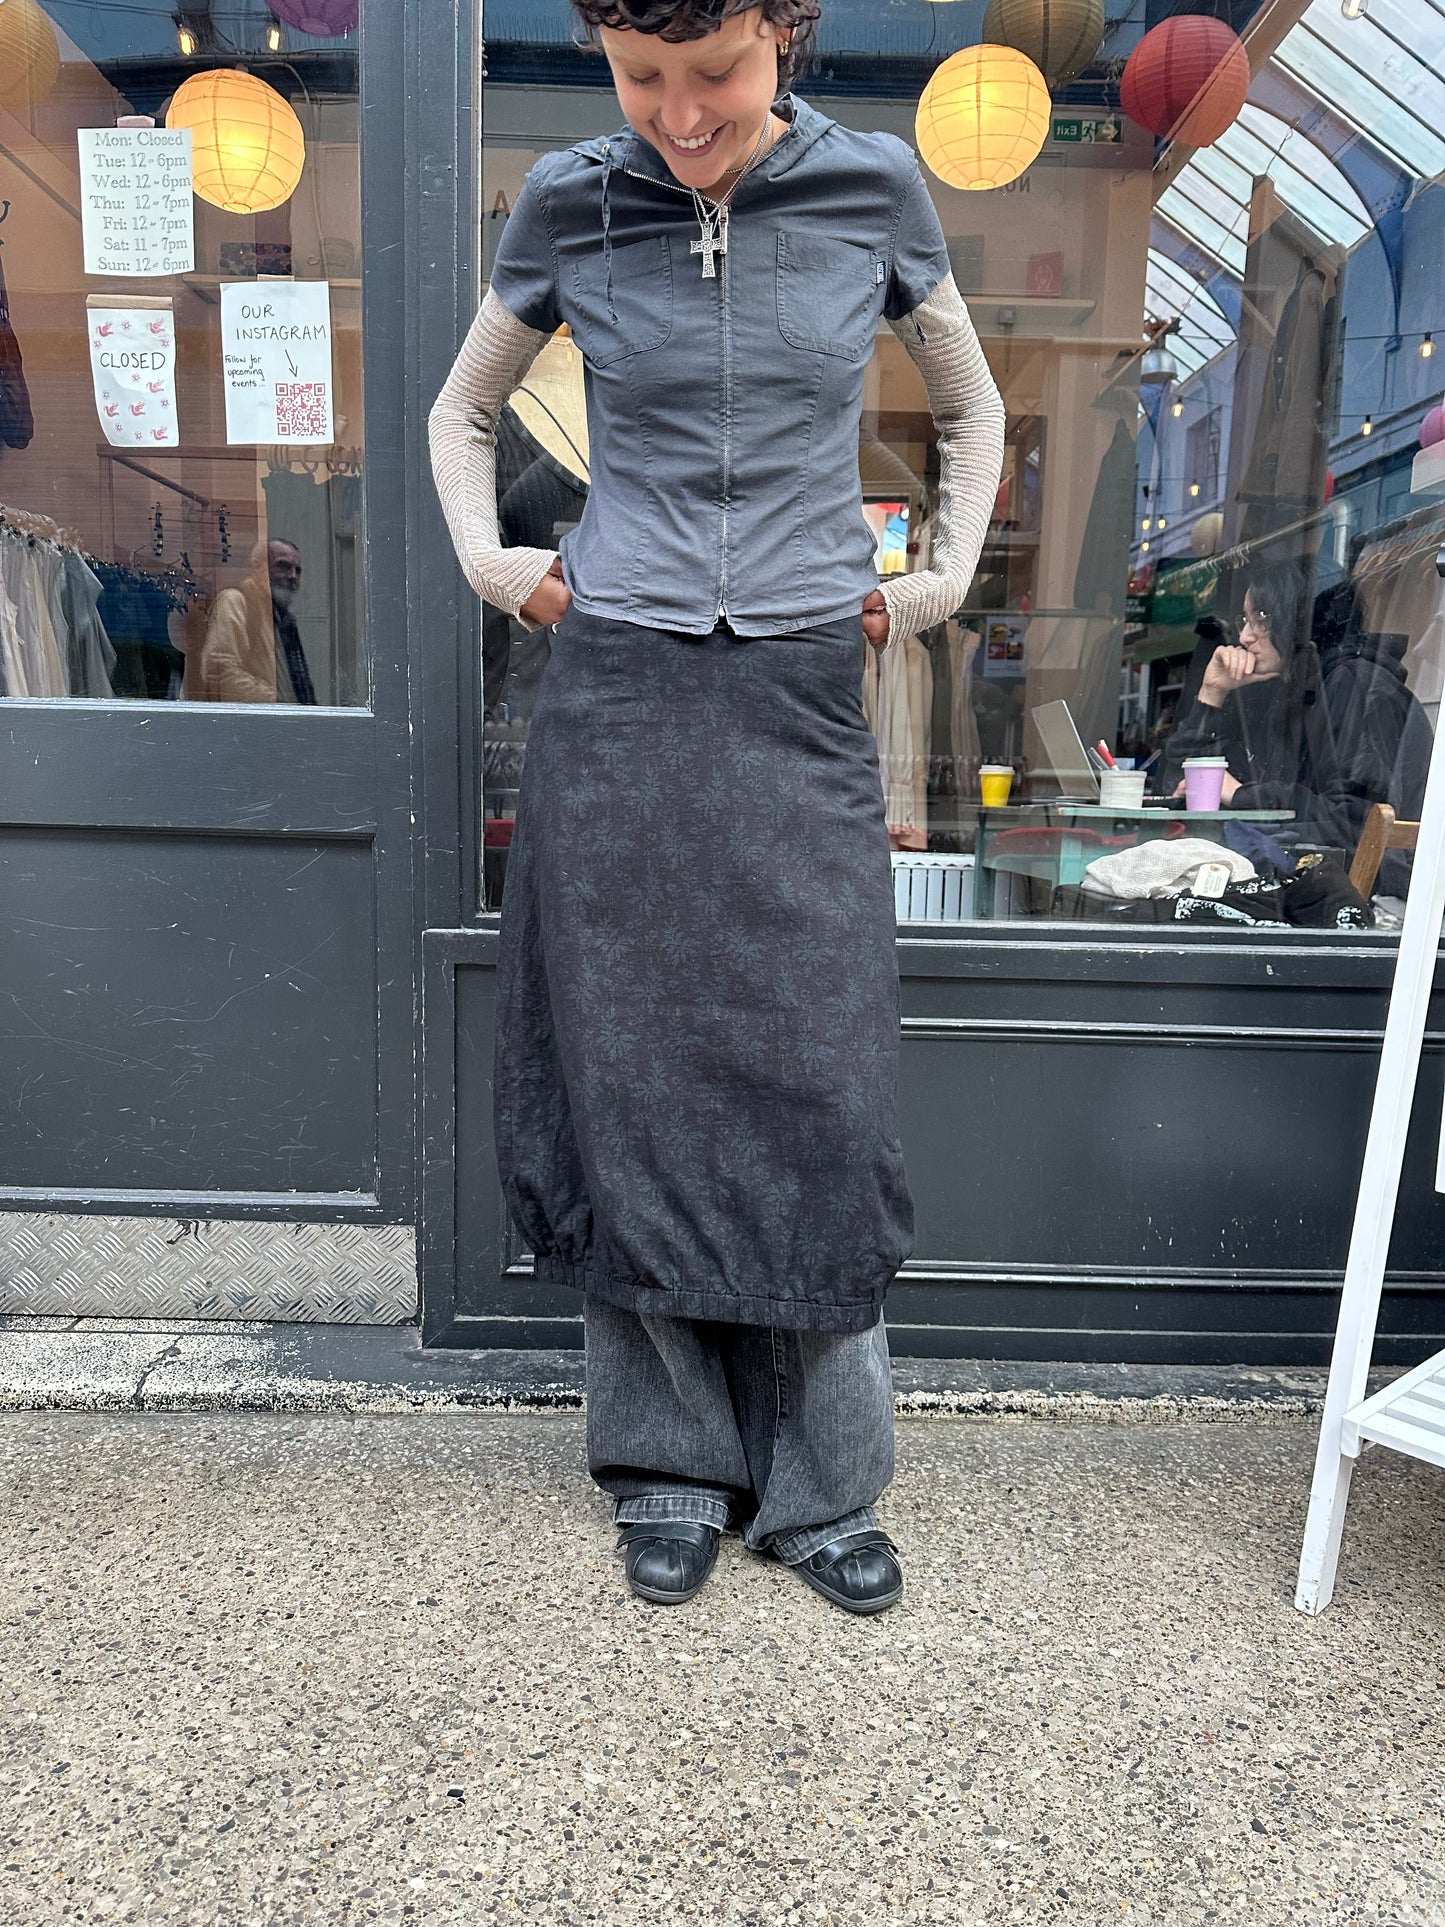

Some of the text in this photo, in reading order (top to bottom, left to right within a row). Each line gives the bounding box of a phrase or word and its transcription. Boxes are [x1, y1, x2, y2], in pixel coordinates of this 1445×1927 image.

[95, 131, 184, 146] Mon: Closed
[93, 154, 126, 167] Tue:
[91, 174, 131, 188] Wed:
[89, 195, 125, 209] Thu:
[103, 216, 127, 230] Fri:
[103, 236, 129, 251] Sat:
[97, 256, 130, 271] Sun:
[241, 304, 275, 319] OUR
[236, 324, 327, 340] INSTAGRAM
[99, 351, 166, 371] CLOSED
[224, 353, 262, 369] Follow for
[227, 368, 265, 381] upcoming
